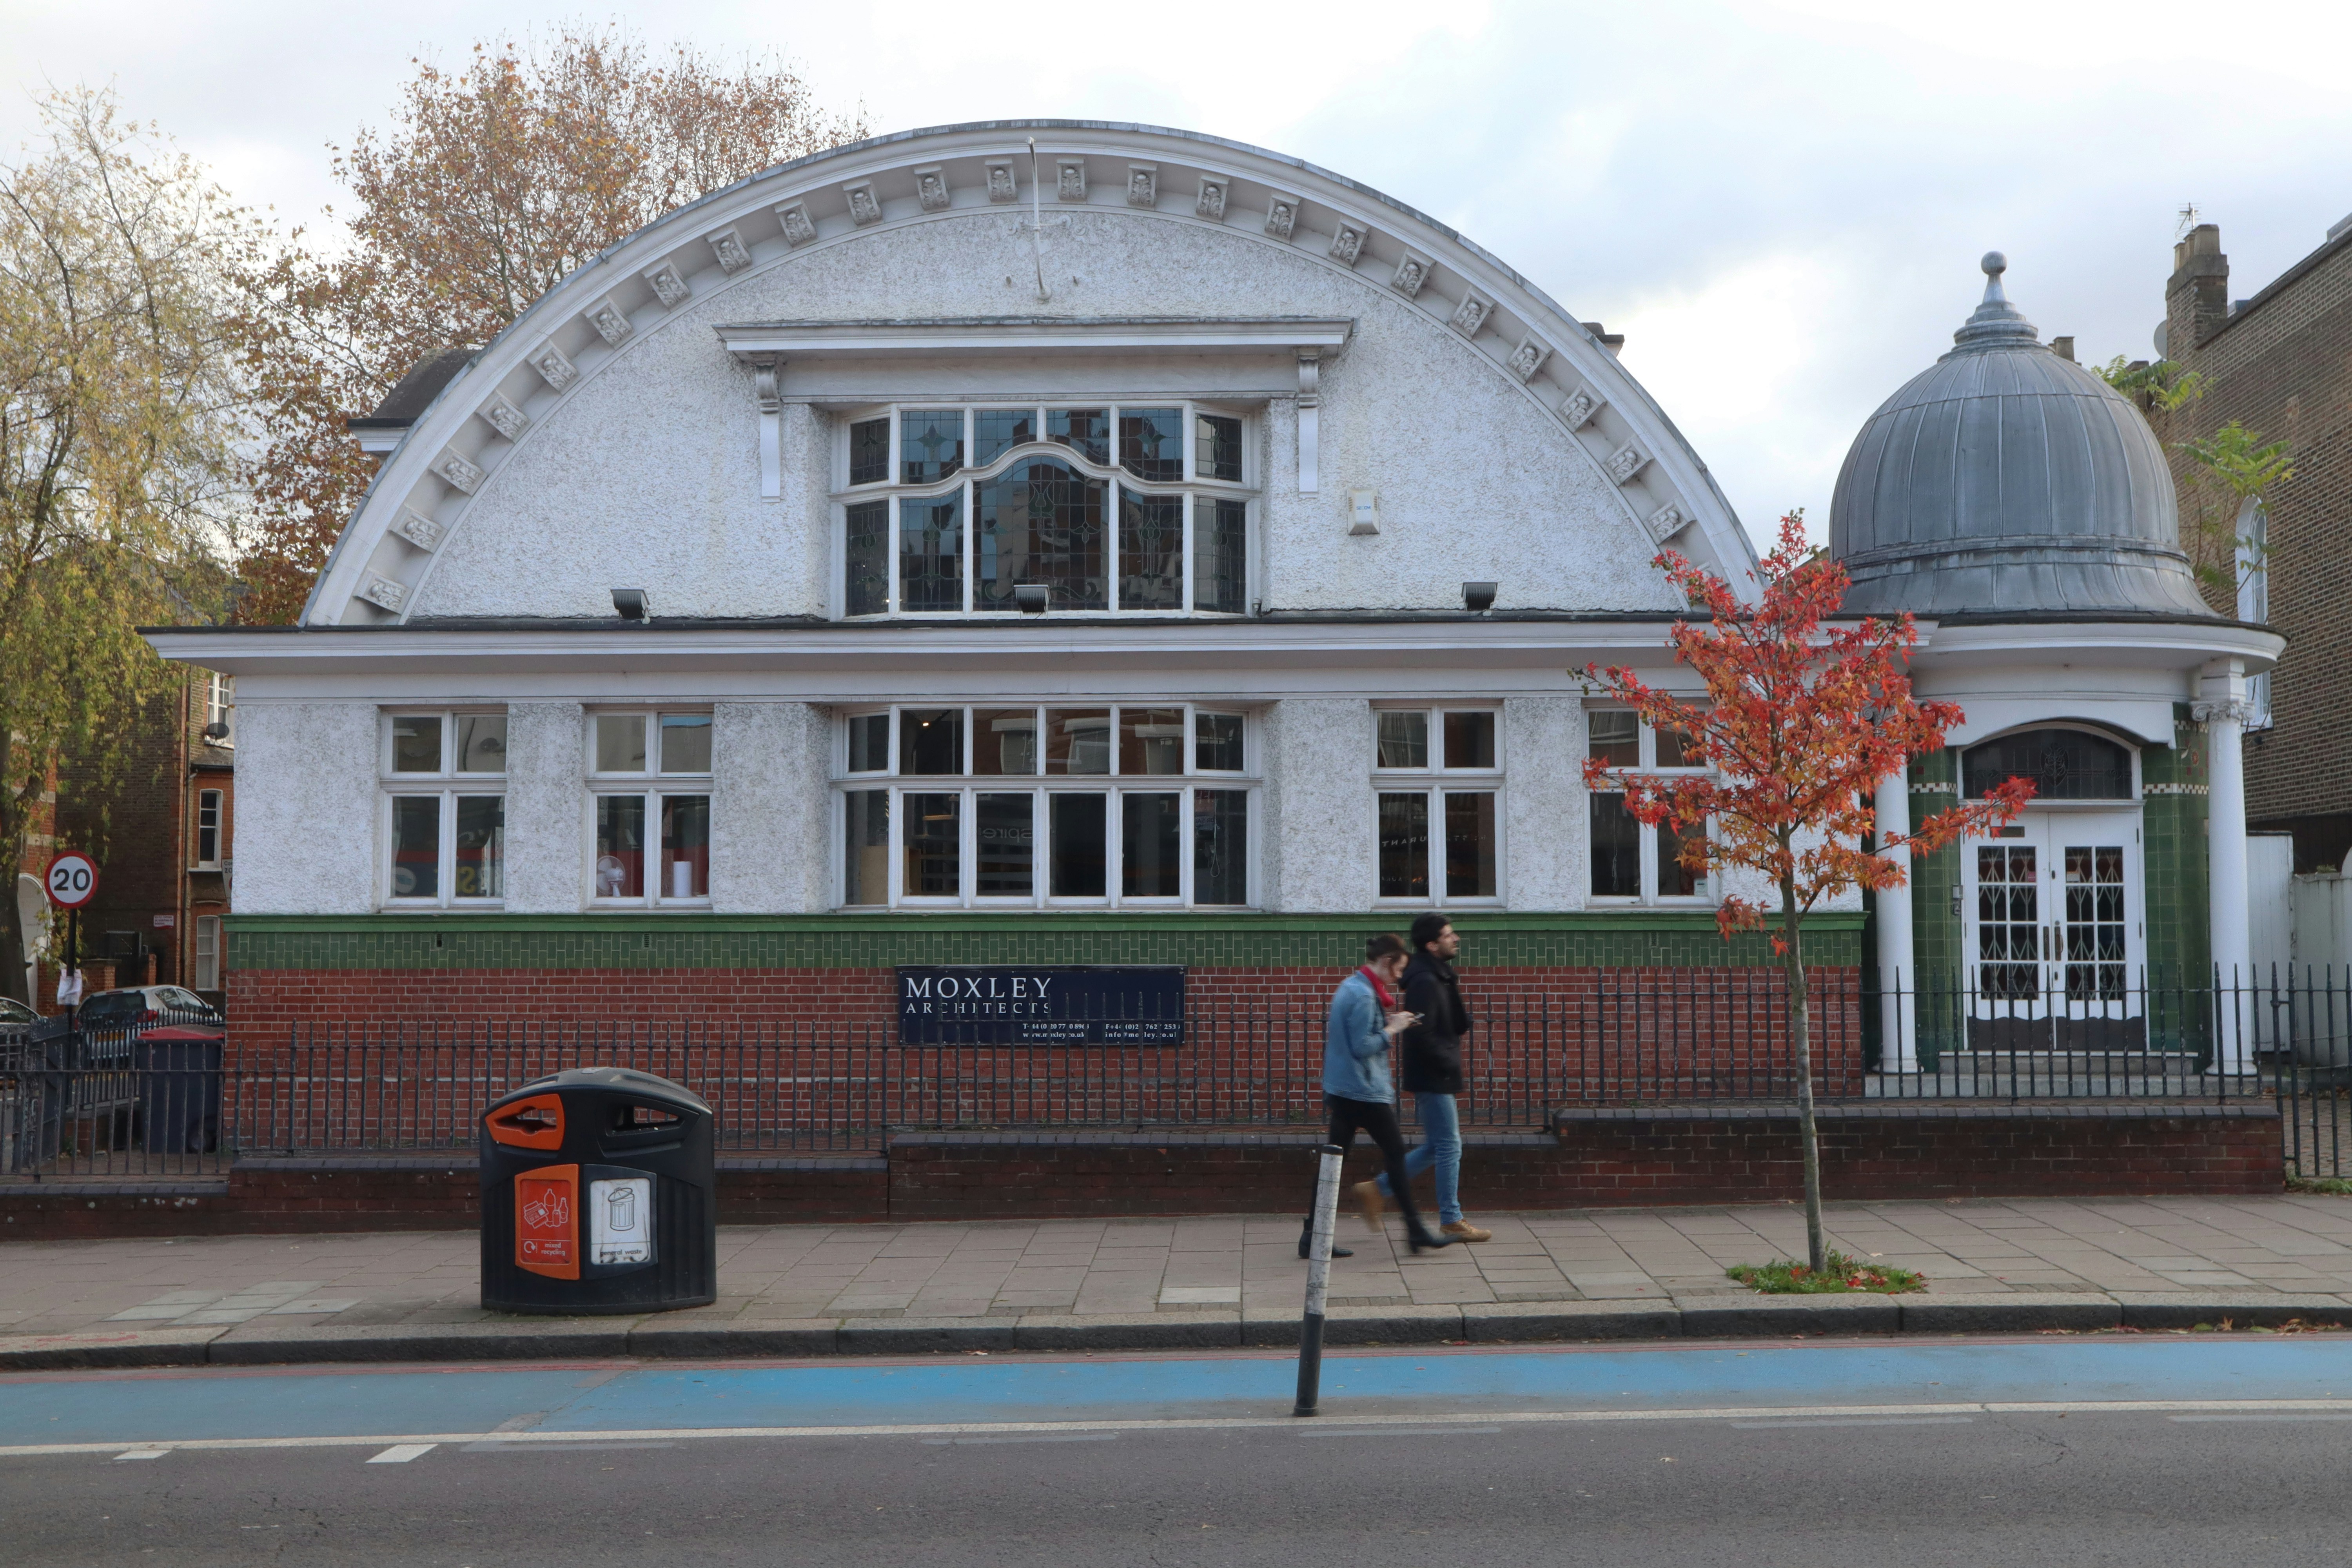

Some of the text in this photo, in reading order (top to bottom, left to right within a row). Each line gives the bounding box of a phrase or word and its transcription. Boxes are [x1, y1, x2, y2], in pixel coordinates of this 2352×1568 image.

[54, 868, 90, 891] 20
[906, 977, 1051, 998] MOXLEY
[906, 1002, 1050, 1014] ARCHITECTS
